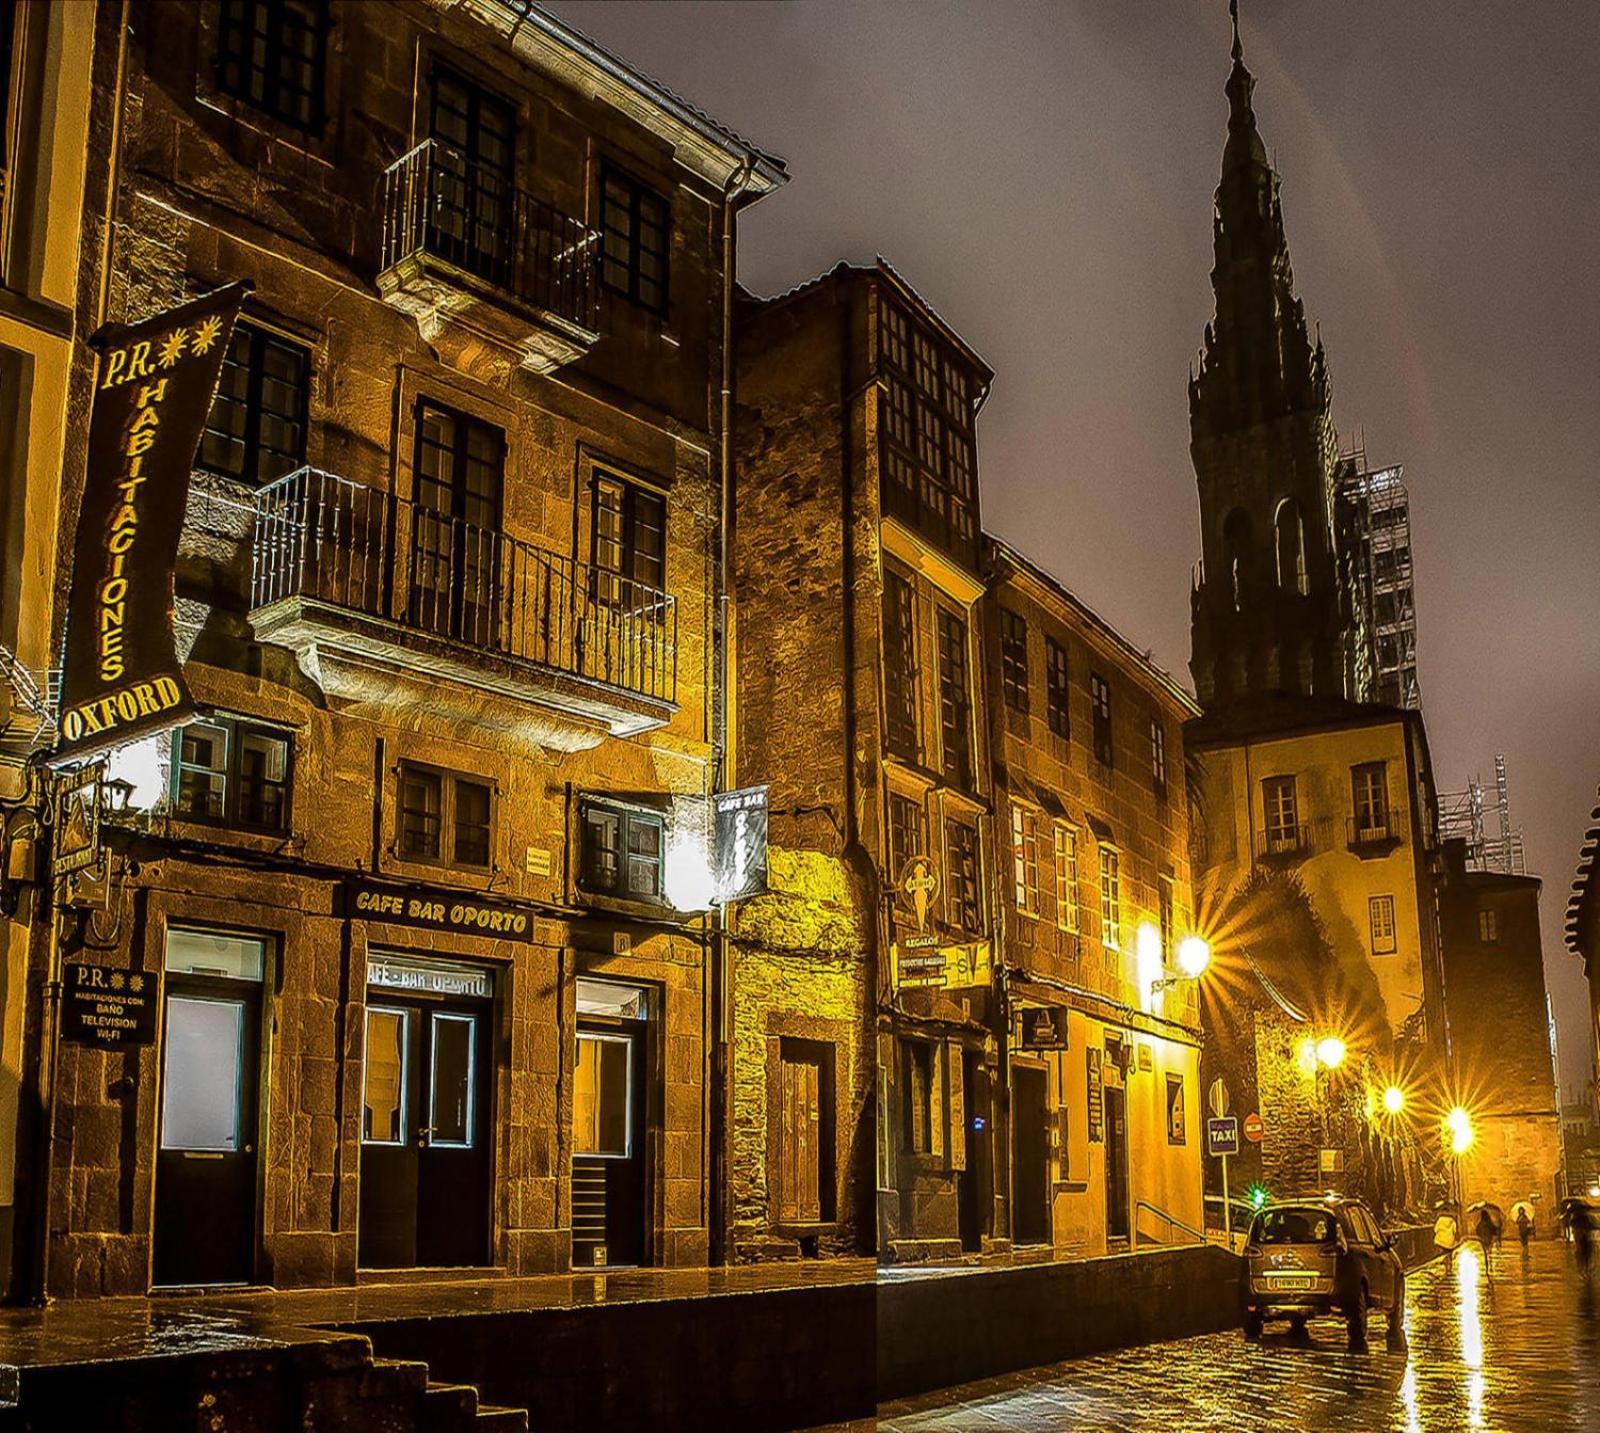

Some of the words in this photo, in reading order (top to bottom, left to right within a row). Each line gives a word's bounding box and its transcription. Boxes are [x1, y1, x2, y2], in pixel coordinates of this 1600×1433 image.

[101, 378, 168, 681] HABITACIONES
[63, 677, 180, 741] OXFORD
[356, 891, 404, 915] CAFE
[408, 900, 446, 923] BAR
[450, 904, 527, 934] OPORTO
[77, 966, 109, 989] P.R.
[96, 1003, 124, 1015] BAÑO
[81, 1014, 137, 1029] TELEVISION
[1211, 1129, 1236, 1142] TAXI
